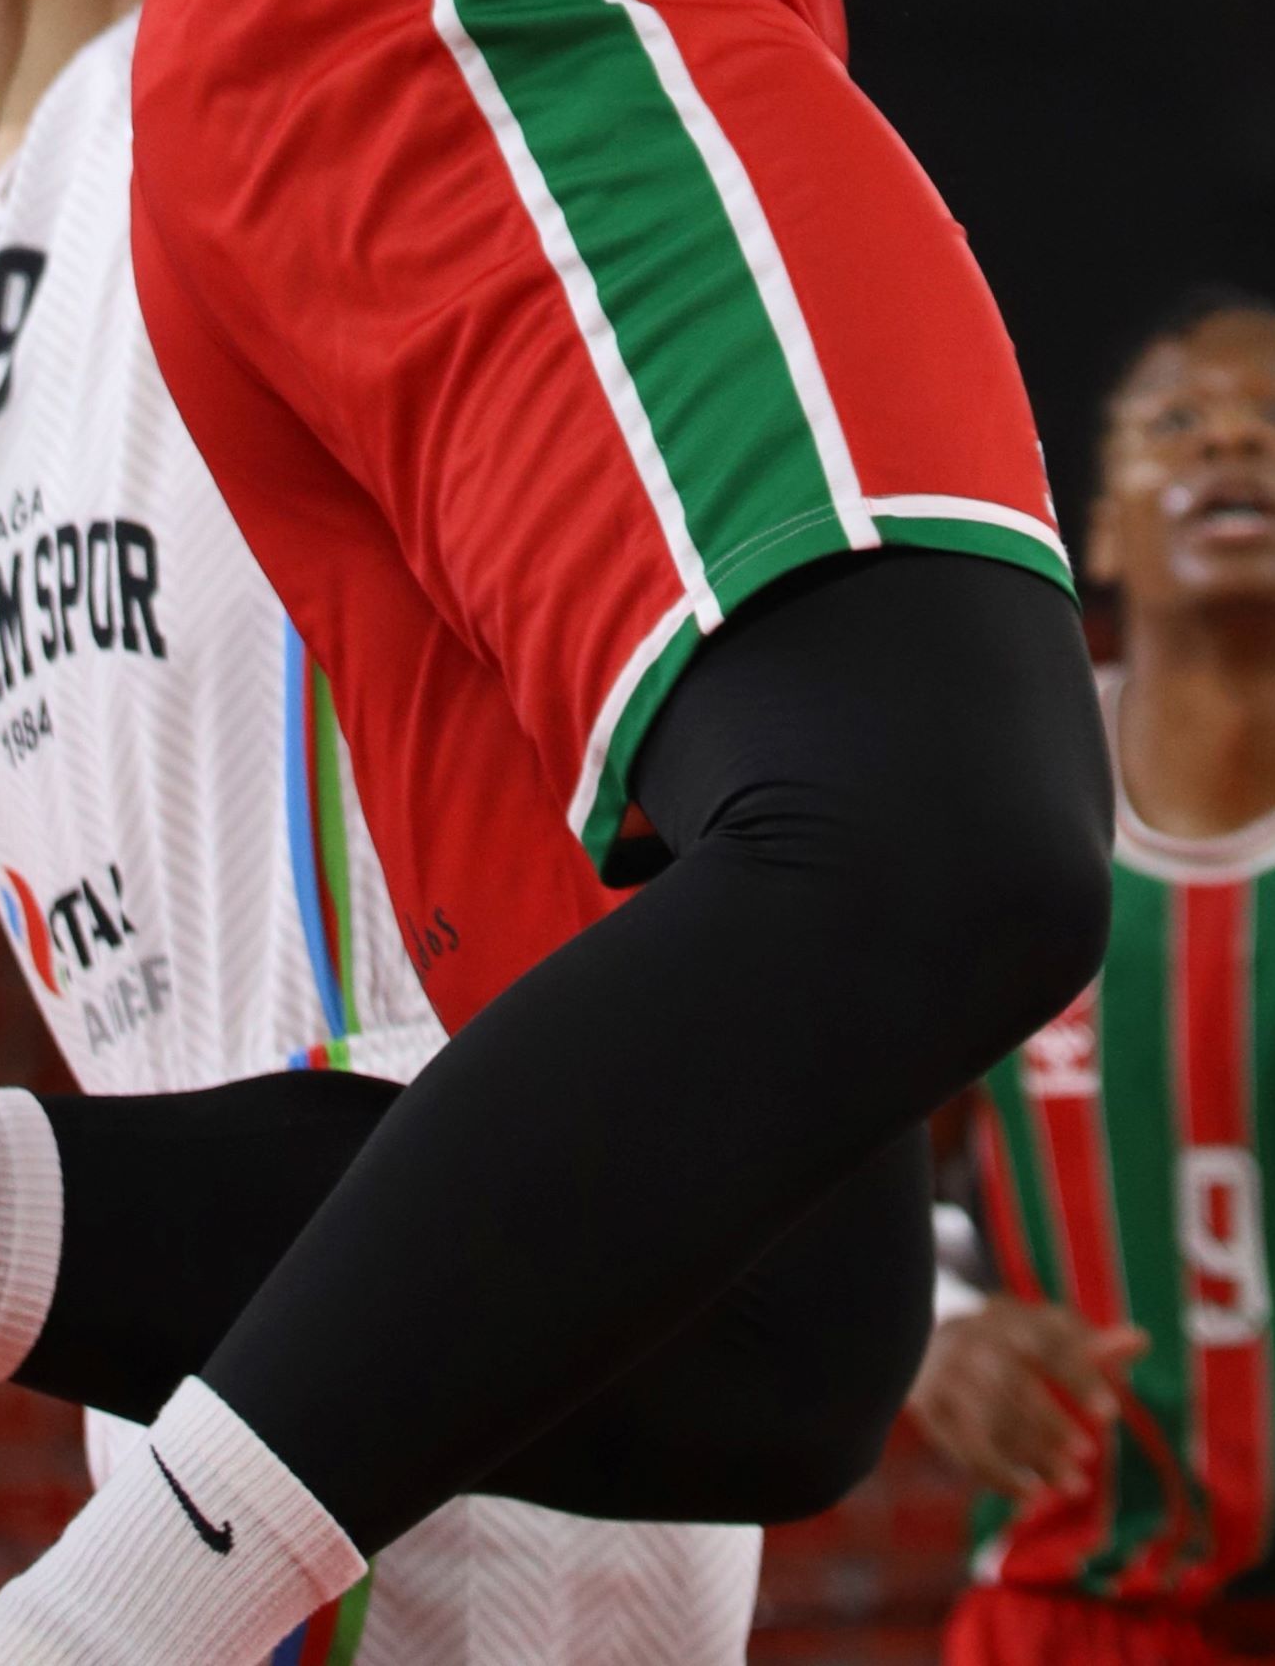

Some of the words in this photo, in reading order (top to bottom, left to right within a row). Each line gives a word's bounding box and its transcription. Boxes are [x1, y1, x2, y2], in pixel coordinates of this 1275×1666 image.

[34, 518, 168, 664] SPOR
[1, 697, 54, 769] 1984
[1175, 1142, 1272, 1349] 9
